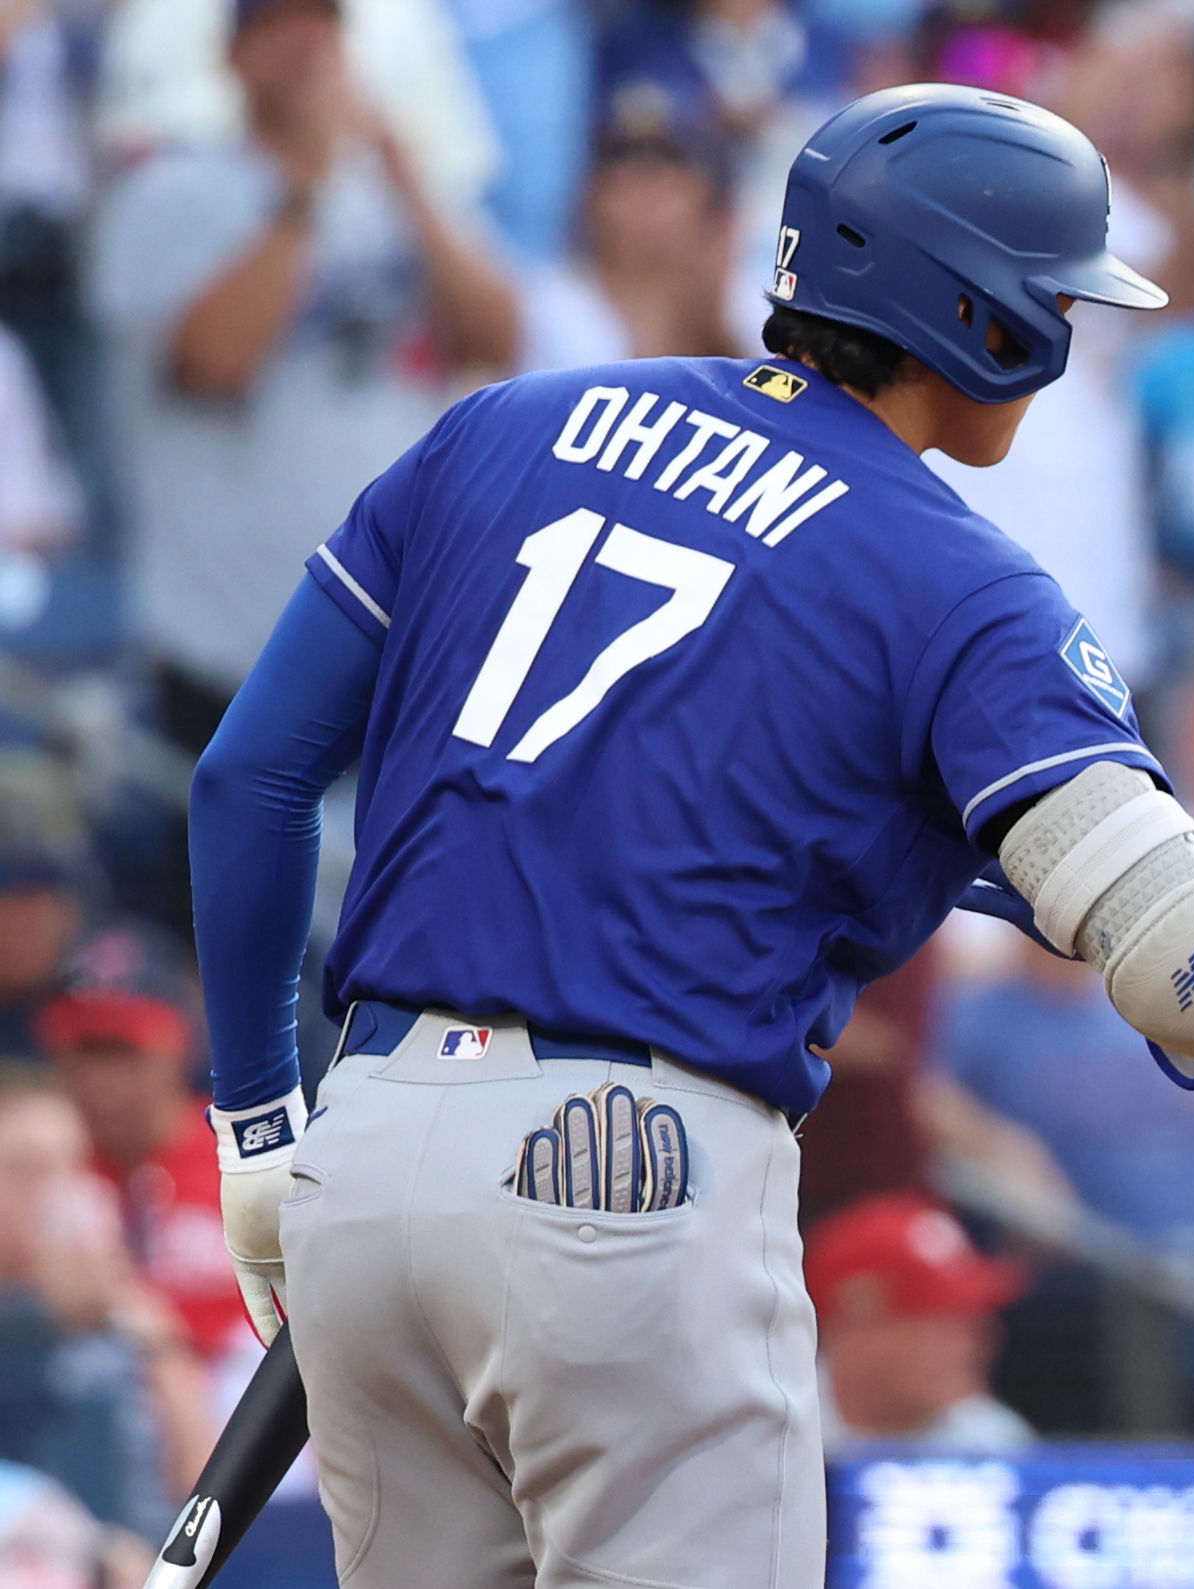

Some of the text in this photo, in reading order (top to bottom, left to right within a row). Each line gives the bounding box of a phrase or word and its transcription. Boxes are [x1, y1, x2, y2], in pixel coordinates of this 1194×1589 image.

[776, 225, 800, 268] 17
[552, 385, 851, 549] OHTANI
[452, 506, 737, 764] 17
